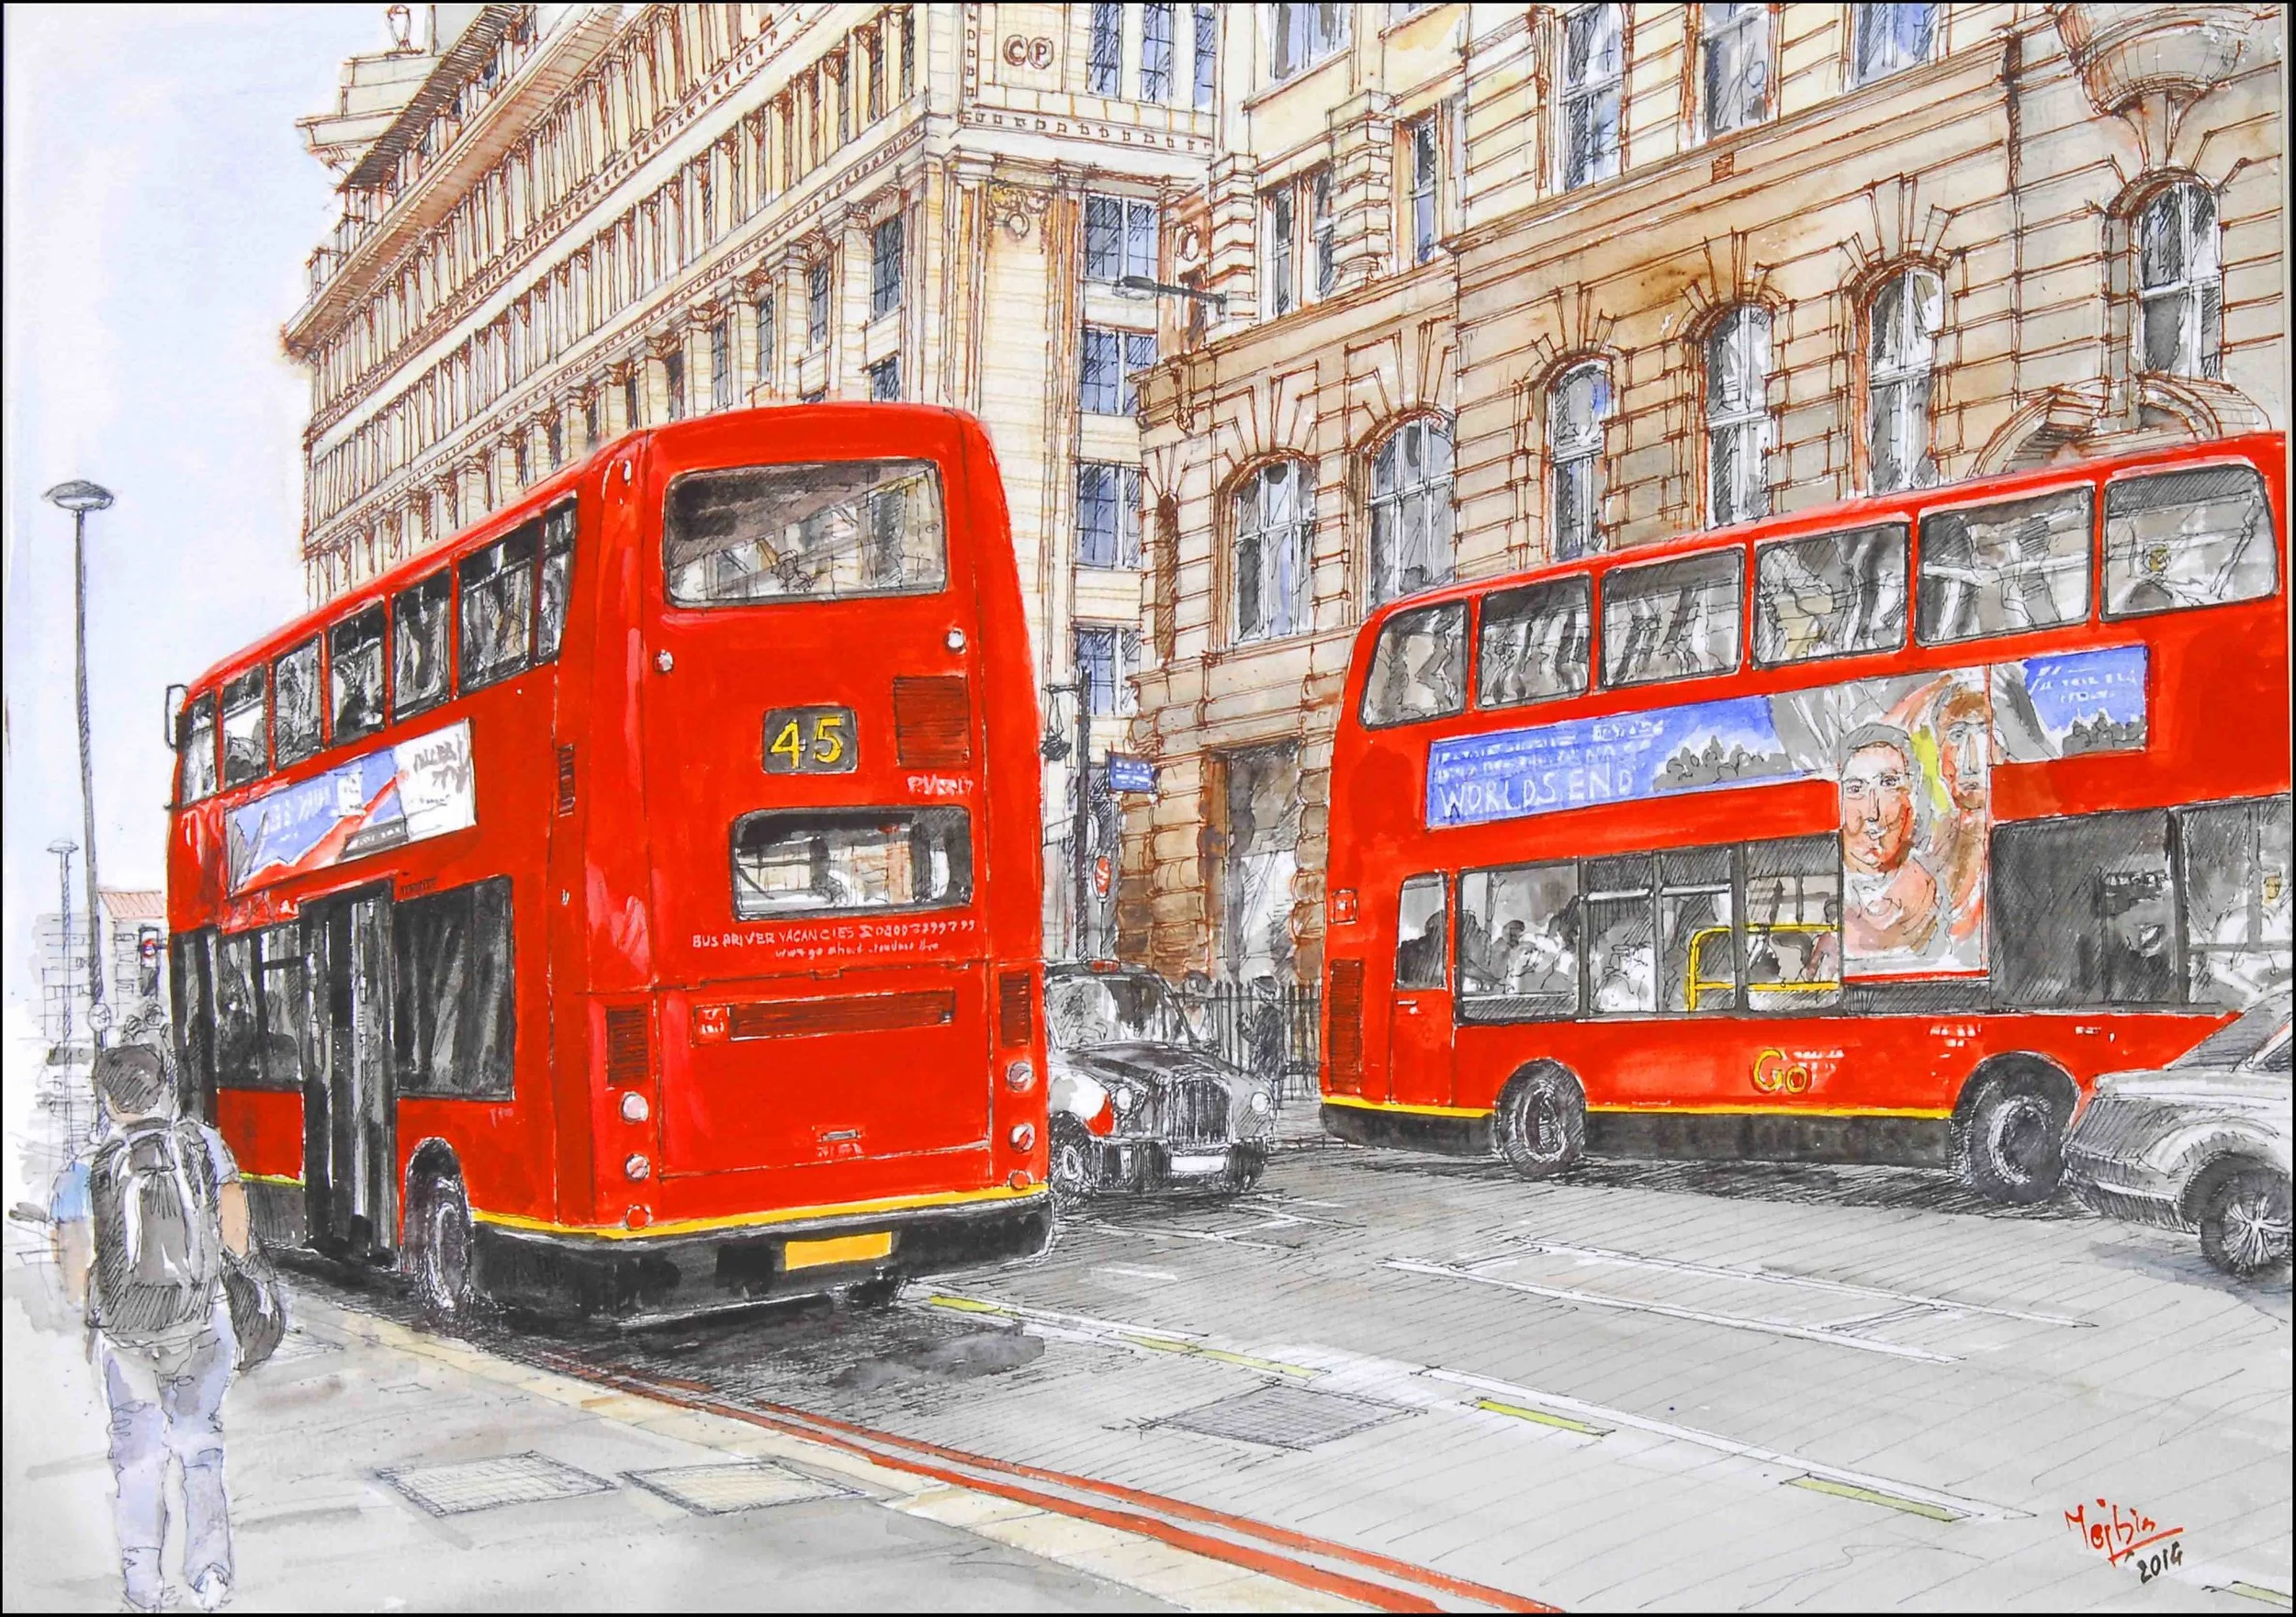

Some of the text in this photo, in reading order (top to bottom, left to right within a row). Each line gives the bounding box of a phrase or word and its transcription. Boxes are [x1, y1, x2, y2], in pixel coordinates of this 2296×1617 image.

[770, 714, 843, 769] 45
[1439, 771, 1557, 817] WORLDS
[1569, 761, 1633, 801] END
[692, 933, 719, 949] BUS
[1751, 1048, 1809, 1095] Go
